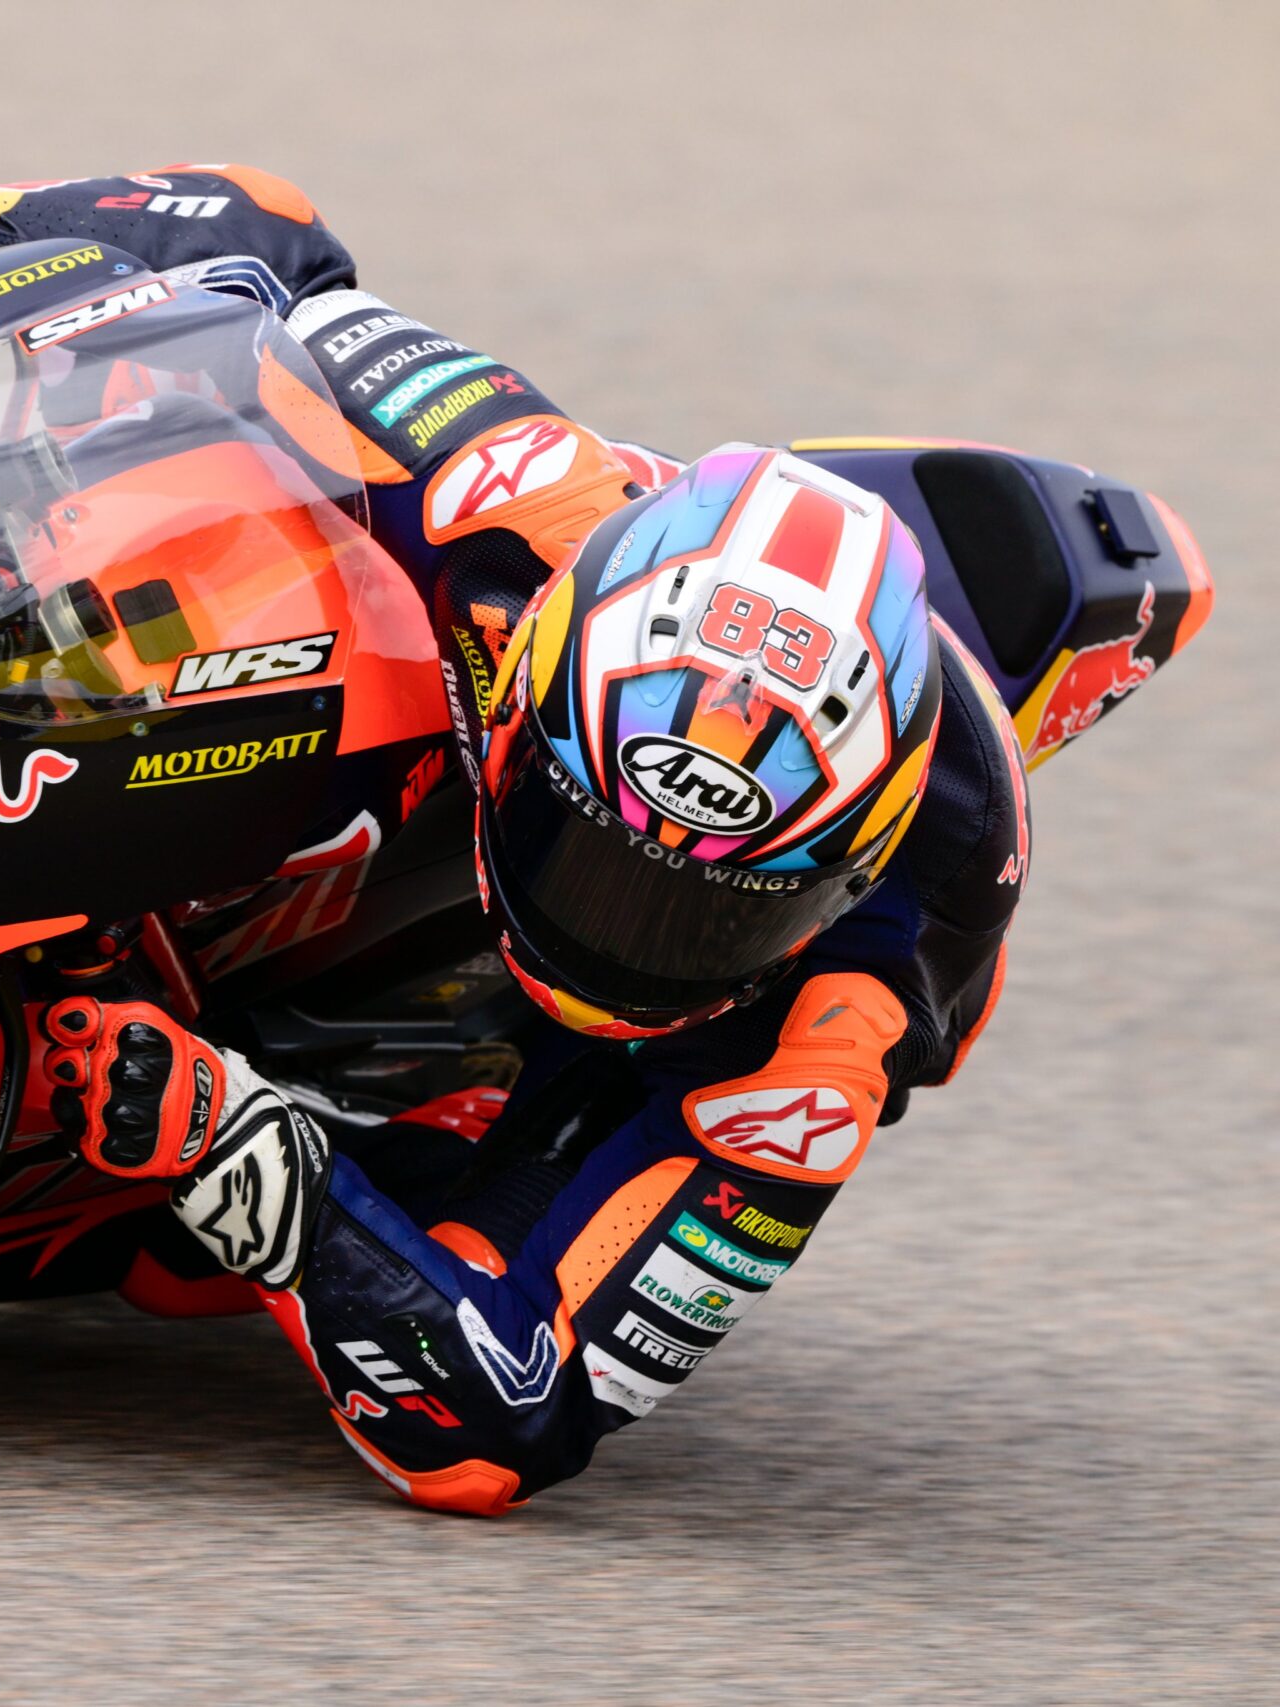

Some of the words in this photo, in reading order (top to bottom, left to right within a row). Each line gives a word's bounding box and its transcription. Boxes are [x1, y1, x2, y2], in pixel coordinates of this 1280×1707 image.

[27, 280, 170, 350] WRS
[378, 360, 473, 420] MOTOREX
[177, 634, 334, 694] WRS
[697, 582, 837, 693] 83
[124, 729, 328, 790] MOTOBATT
[625, 751, 761, 820] Arai
[547, 759, 611, 828] GIVES
[626, 830, 686, 870] YOU
[703, 865, 802, 891] WINGS
